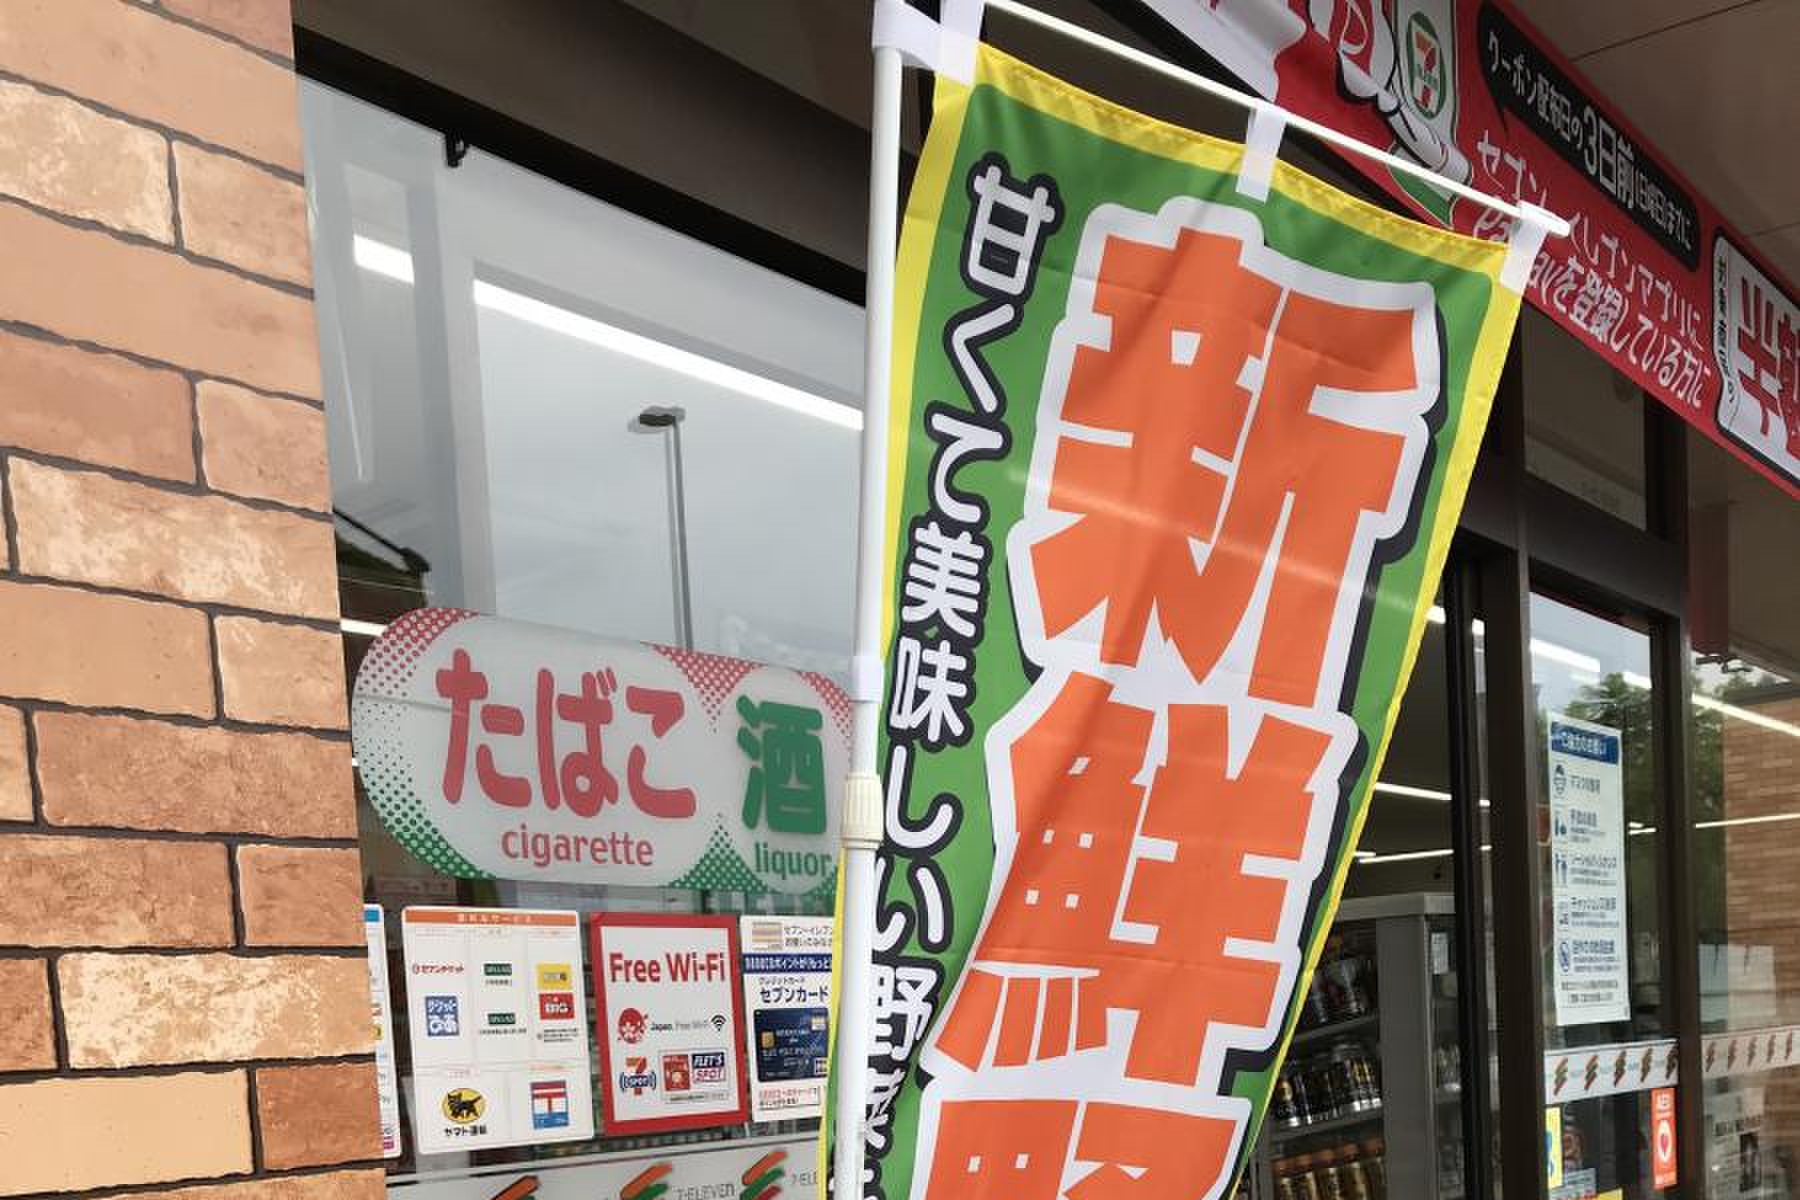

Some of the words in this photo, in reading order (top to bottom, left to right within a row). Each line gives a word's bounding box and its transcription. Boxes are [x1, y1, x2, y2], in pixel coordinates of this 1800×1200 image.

[435, 648, 697, 818] たばこ
[736, 694, 828, 834] 酒
[501, 823, 654, 867] cigarette
[755, 841, 834, 881] liquor
[609, 952, 661, 983] Free
[666, 951, 726, 982] Wi-Fi
[759, 985, 829, 1004] セブンカード
